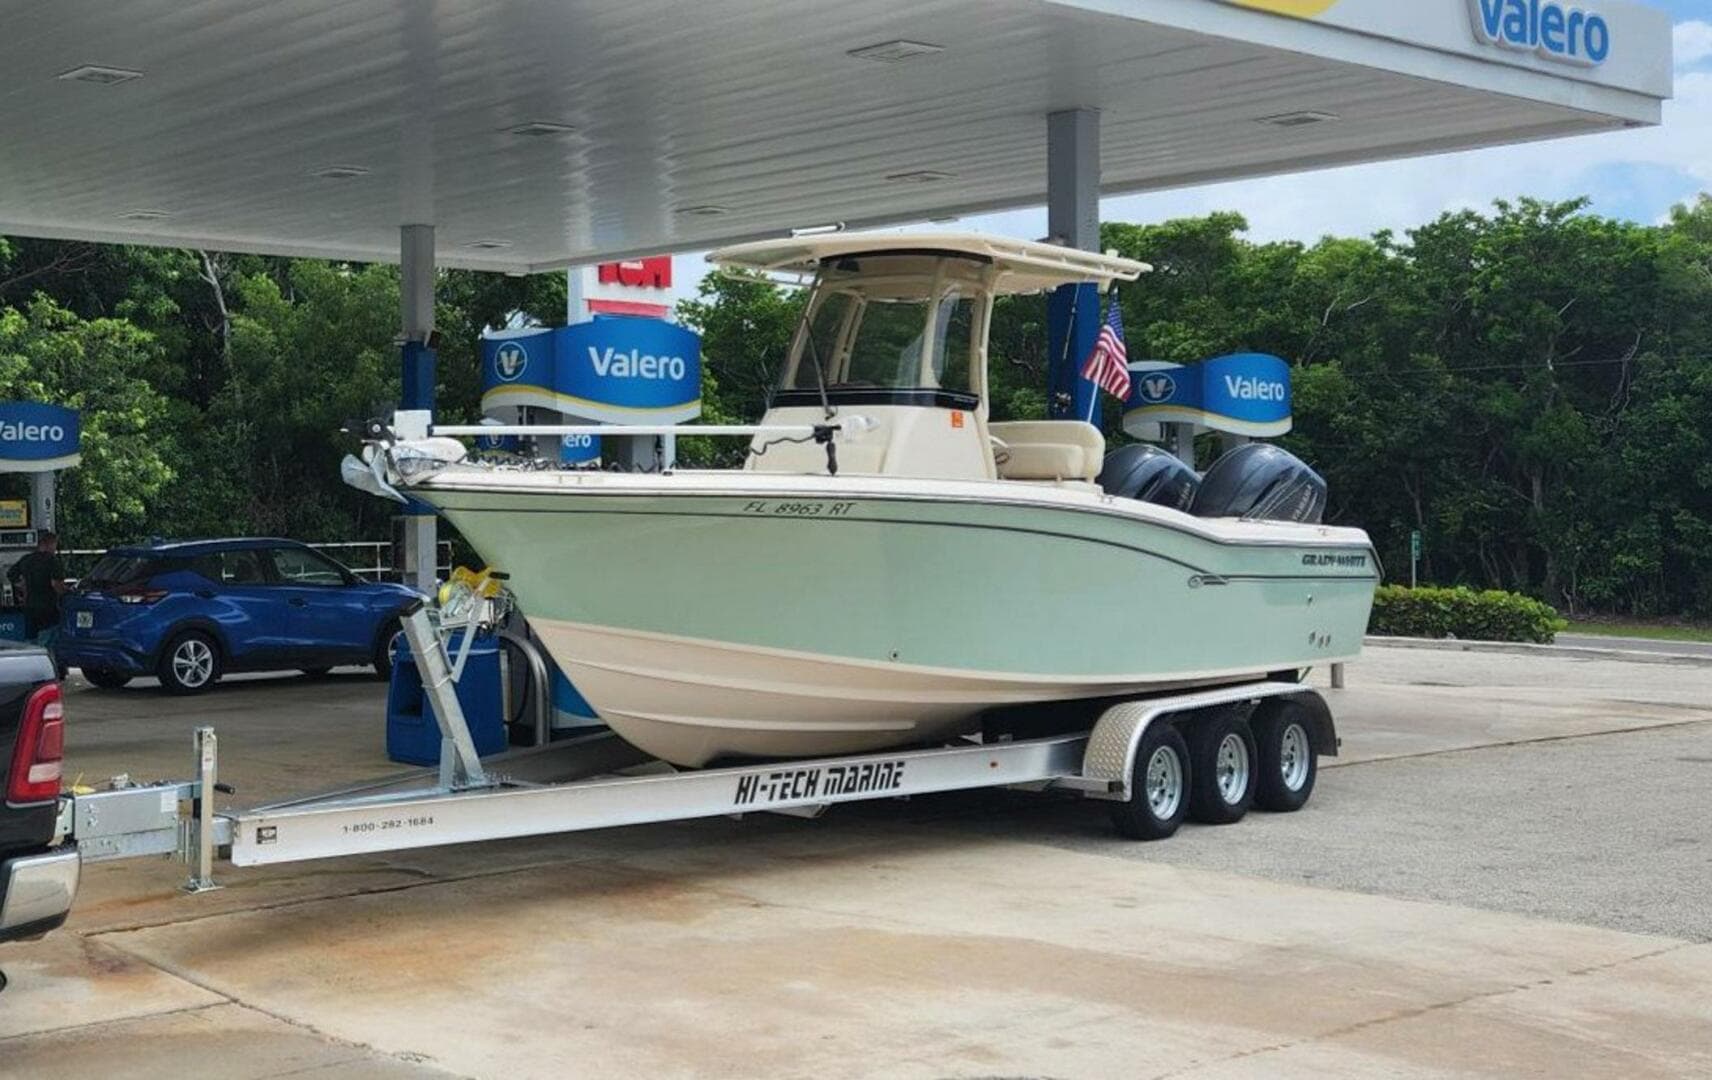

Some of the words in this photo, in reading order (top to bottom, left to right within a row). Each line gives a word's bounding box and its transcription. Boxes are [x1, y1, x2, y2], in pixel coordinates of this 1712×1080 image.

[1480, 0, 1609, 62] Valero
[588, 346, 685, 380] Valero
[1225, 375, 1284, 401] Valero
[744, 501, 767, 513] FL
[829, 503, 857, 515] RT
[734, 769, 820, 805] HI-TECH
[823, 761, 905, 796] MARINE
